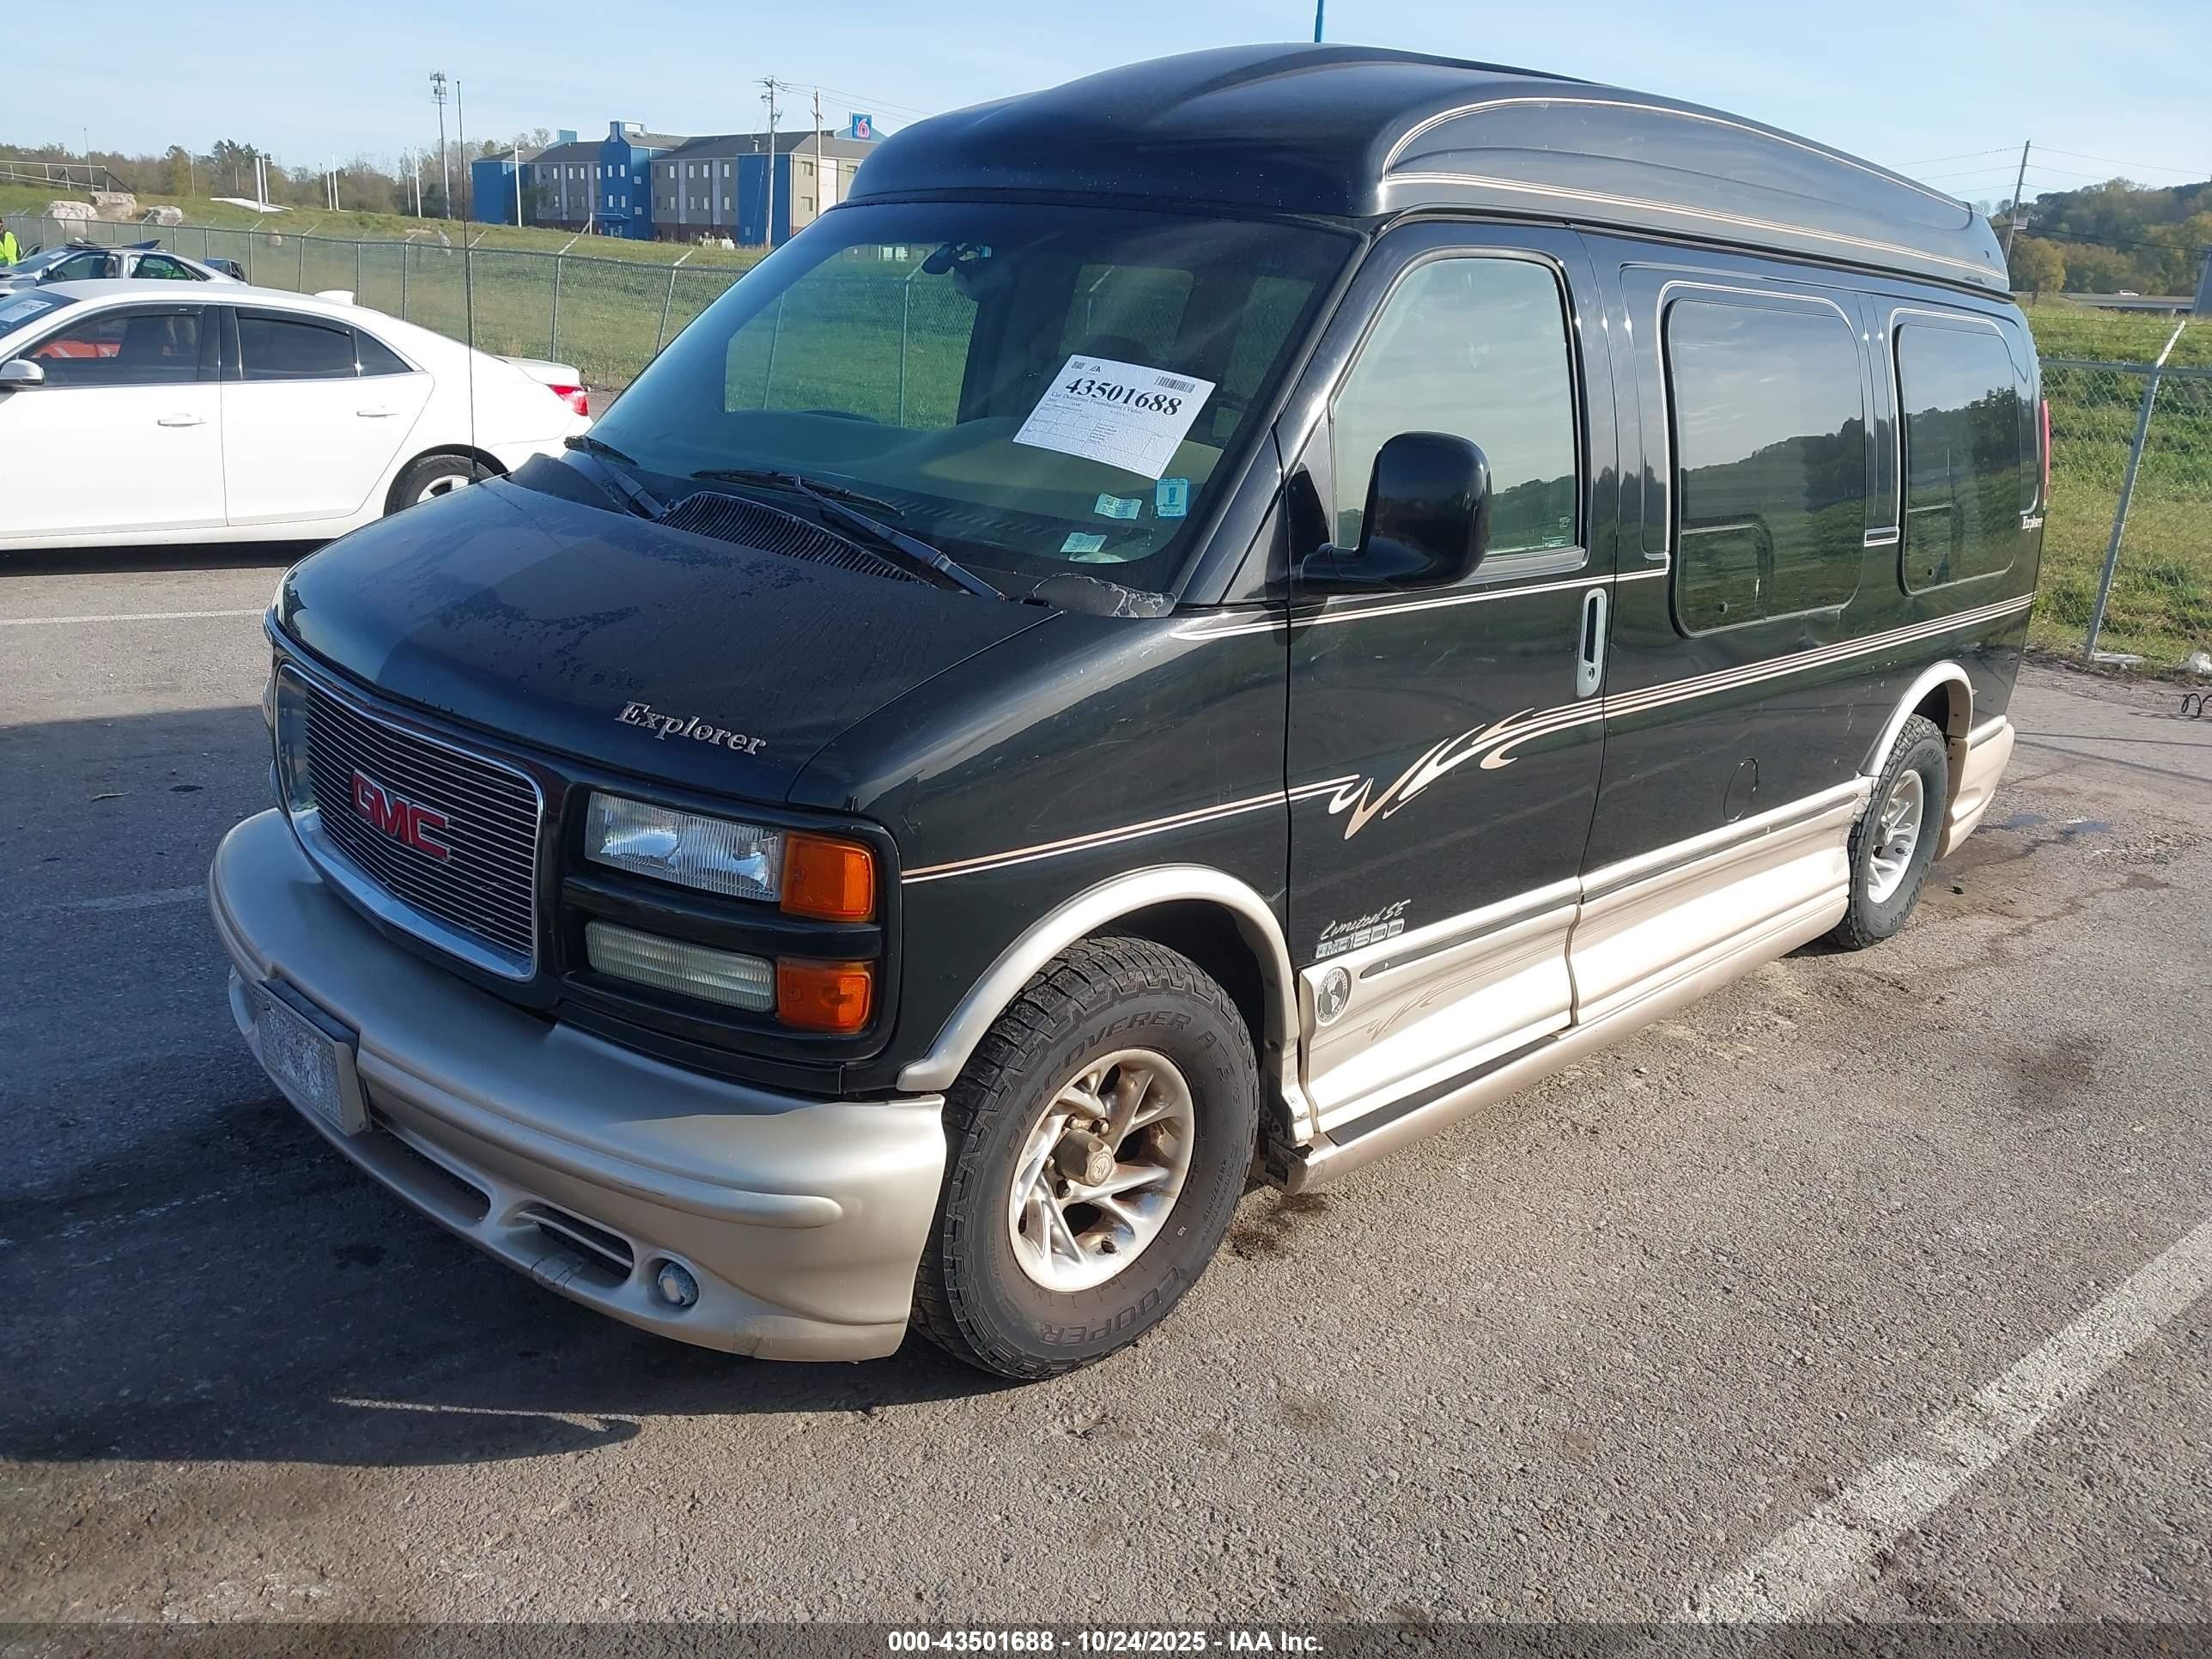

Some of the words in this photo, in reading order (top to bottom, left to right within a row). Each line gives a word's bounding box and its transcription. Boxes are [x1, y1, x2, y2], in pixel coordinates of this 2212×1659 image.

[857, 118, 870, 138] 6
[1066, 377, 1182, 416] 43501688
[614, 701, 767, 756] Explorer
[351, 769, 451, 862] GMC
[1006, 1011, 1192, 1154] DISCOVERER
[1039, 1267, 1181, 1346] COOPER
